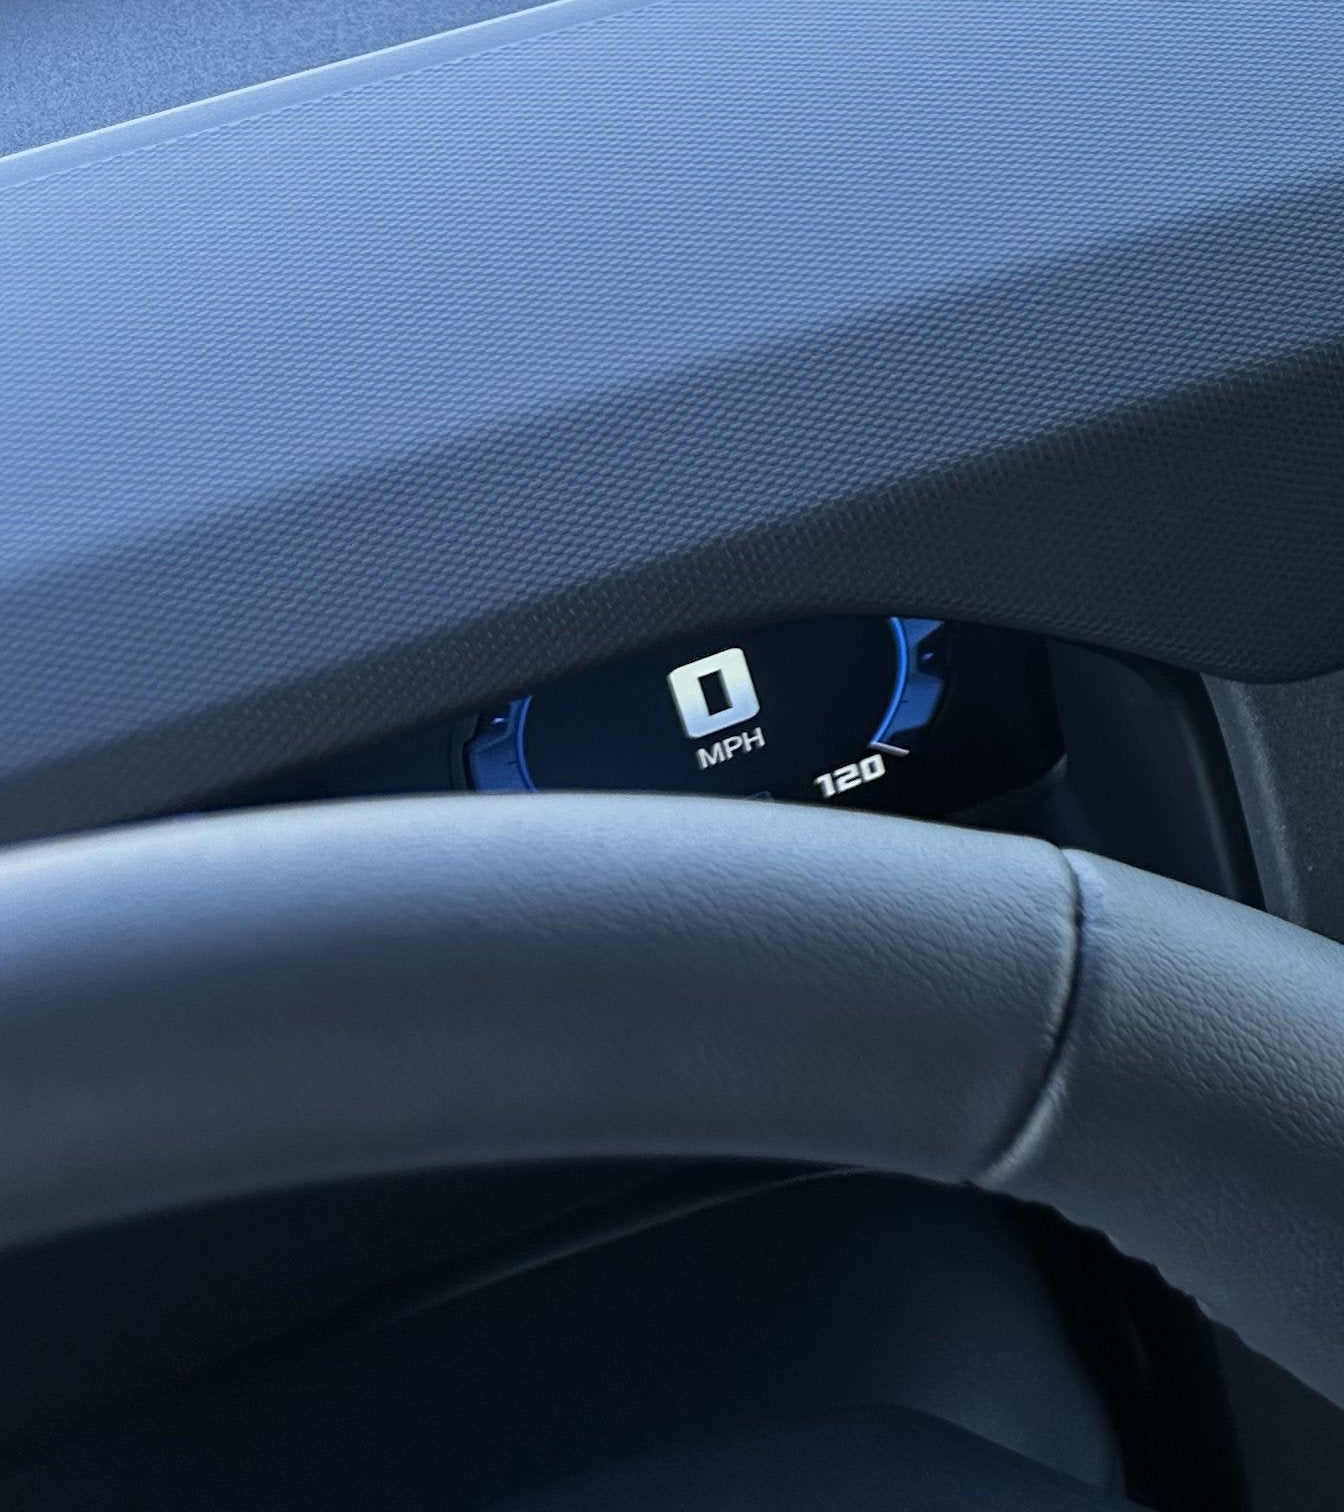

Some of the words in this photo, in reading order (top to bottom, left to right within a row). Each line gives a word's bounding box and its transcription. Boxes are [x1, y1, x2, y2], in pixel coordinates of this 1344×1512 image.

[666, 647, 760, 739] 0
[695, 727, 765, 769] MPH
[812, 754, 887, 798] 120
